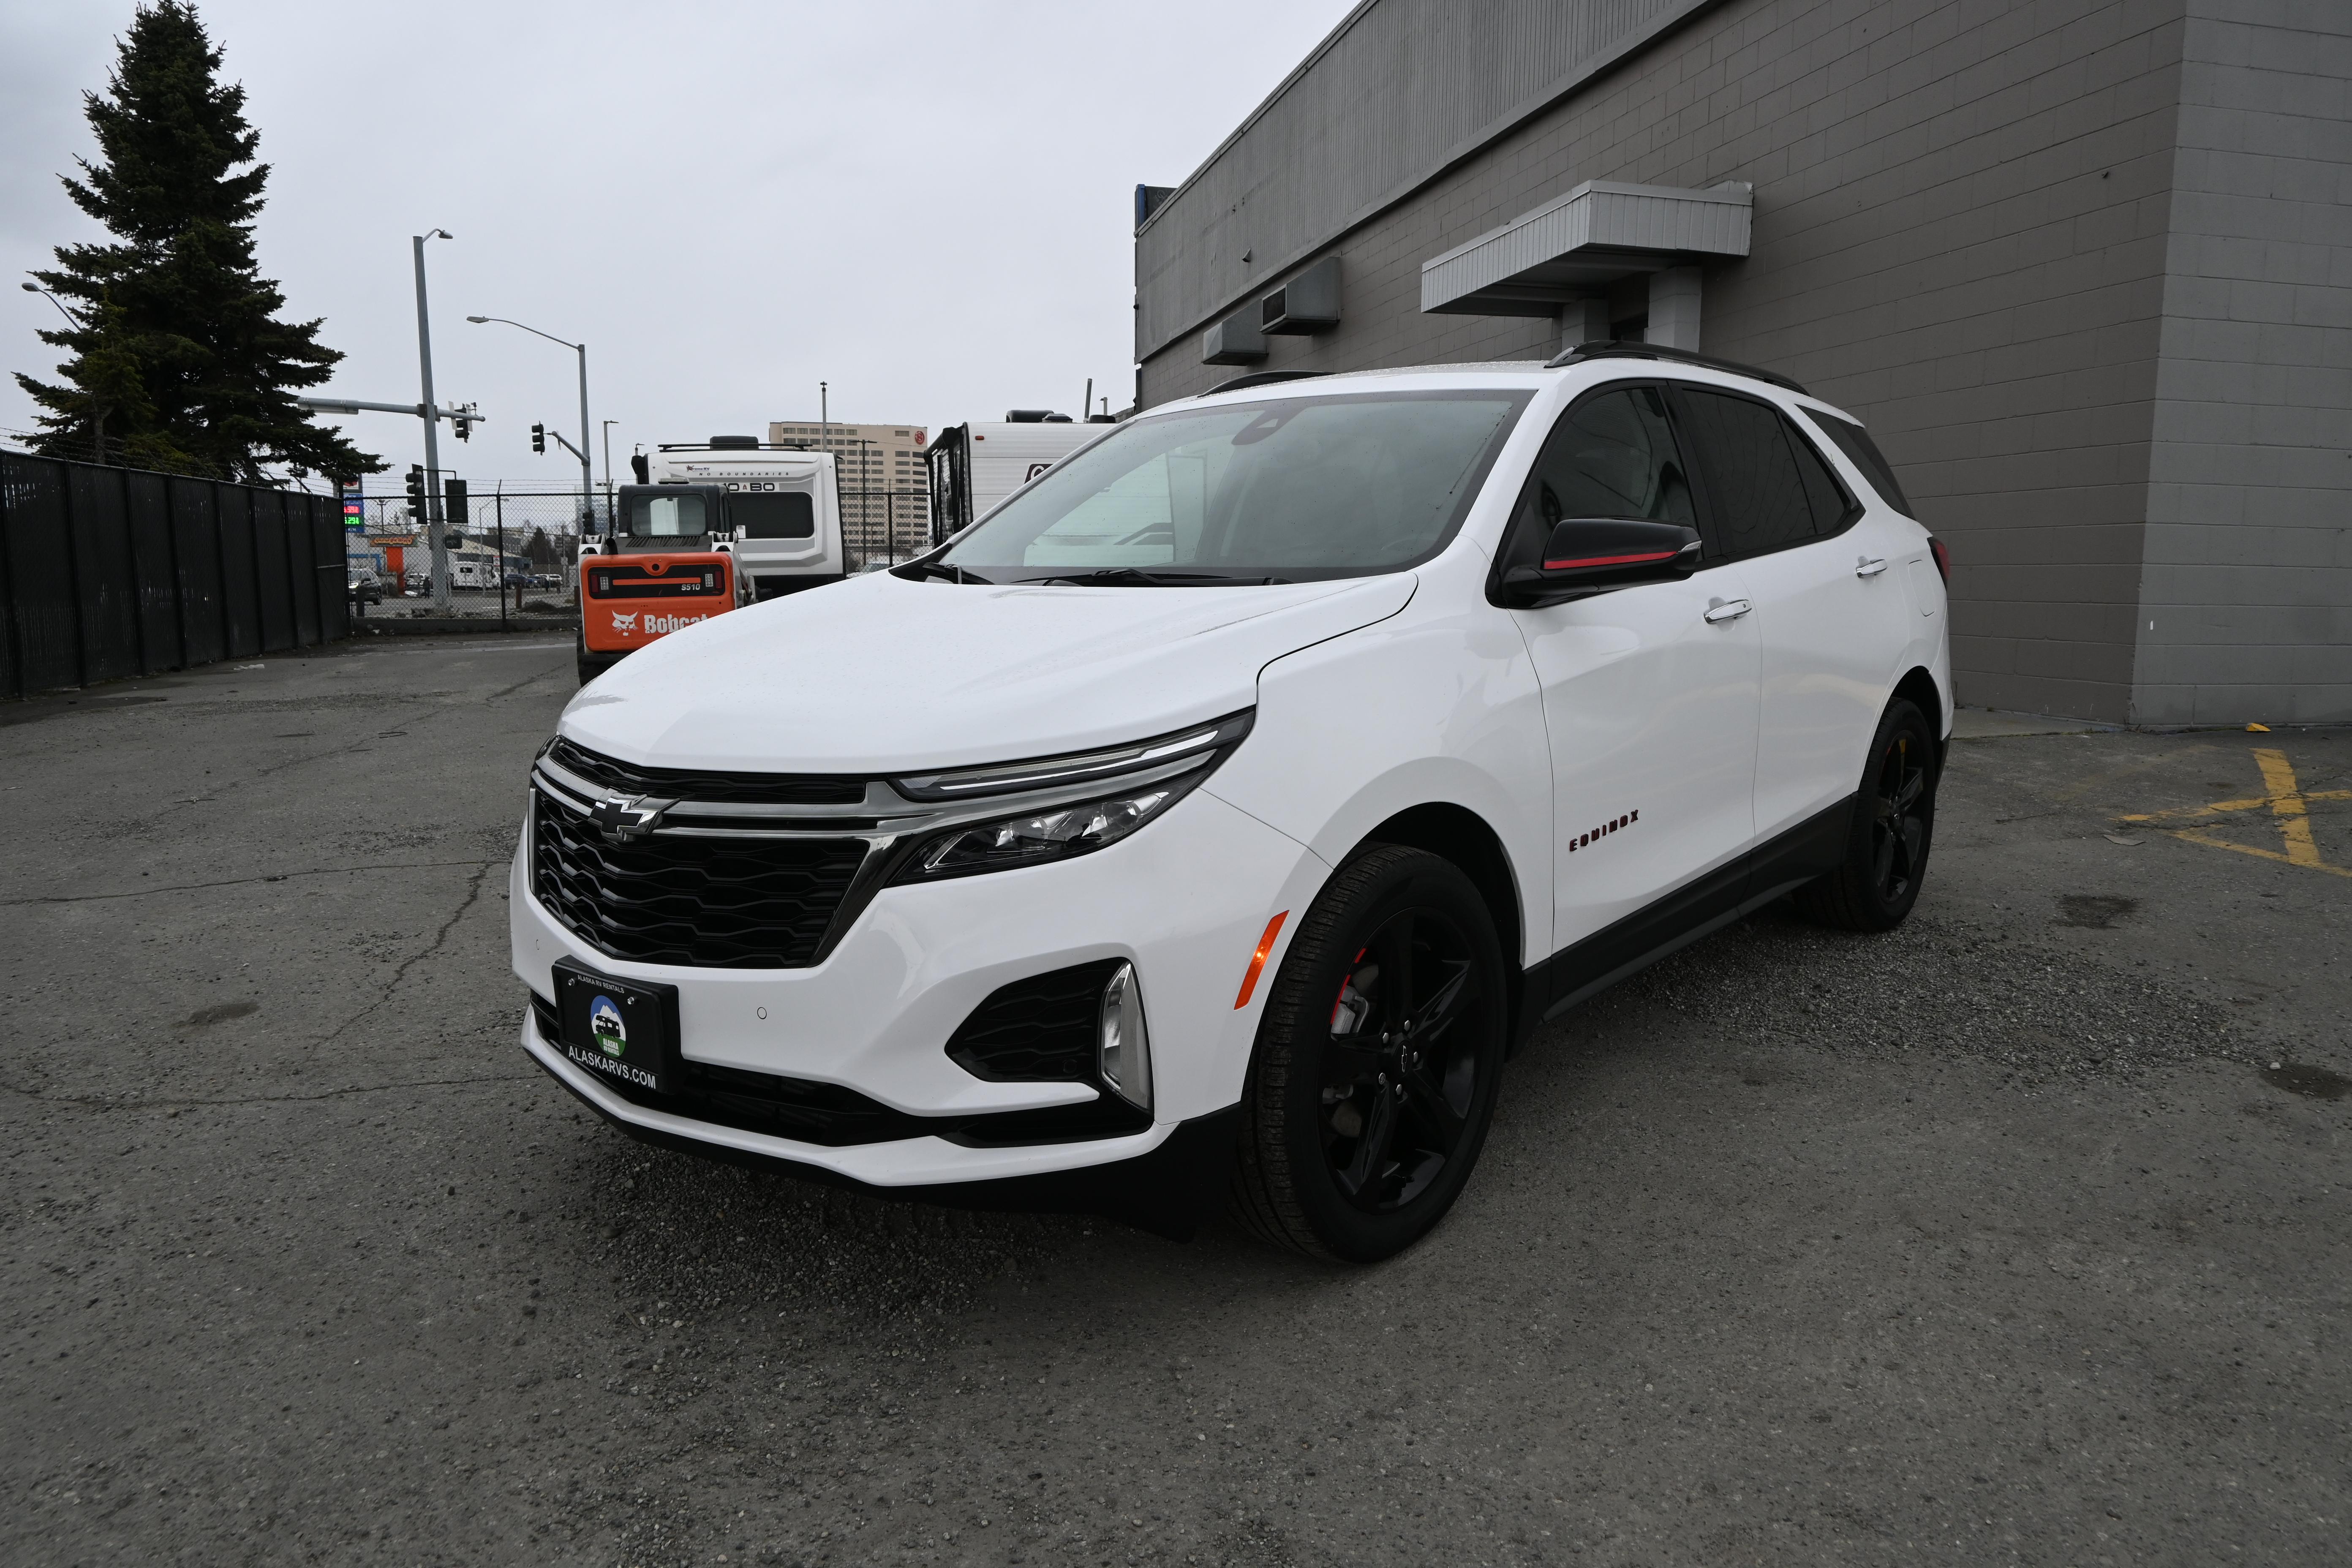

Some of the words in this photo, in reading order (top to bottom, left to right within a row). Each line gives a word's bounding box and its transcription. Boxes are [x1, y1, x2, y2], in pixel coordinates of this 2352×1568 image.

[1569, 809, 1639, 852] EQUINOX
[577, 975, 595, 985] ALASKA
[603, 982, 625, 994] RENTALS
[603, 1038, 619, 1050] ALASKA
[569, 1045, 656, 1089] ALASKARVS.COM
